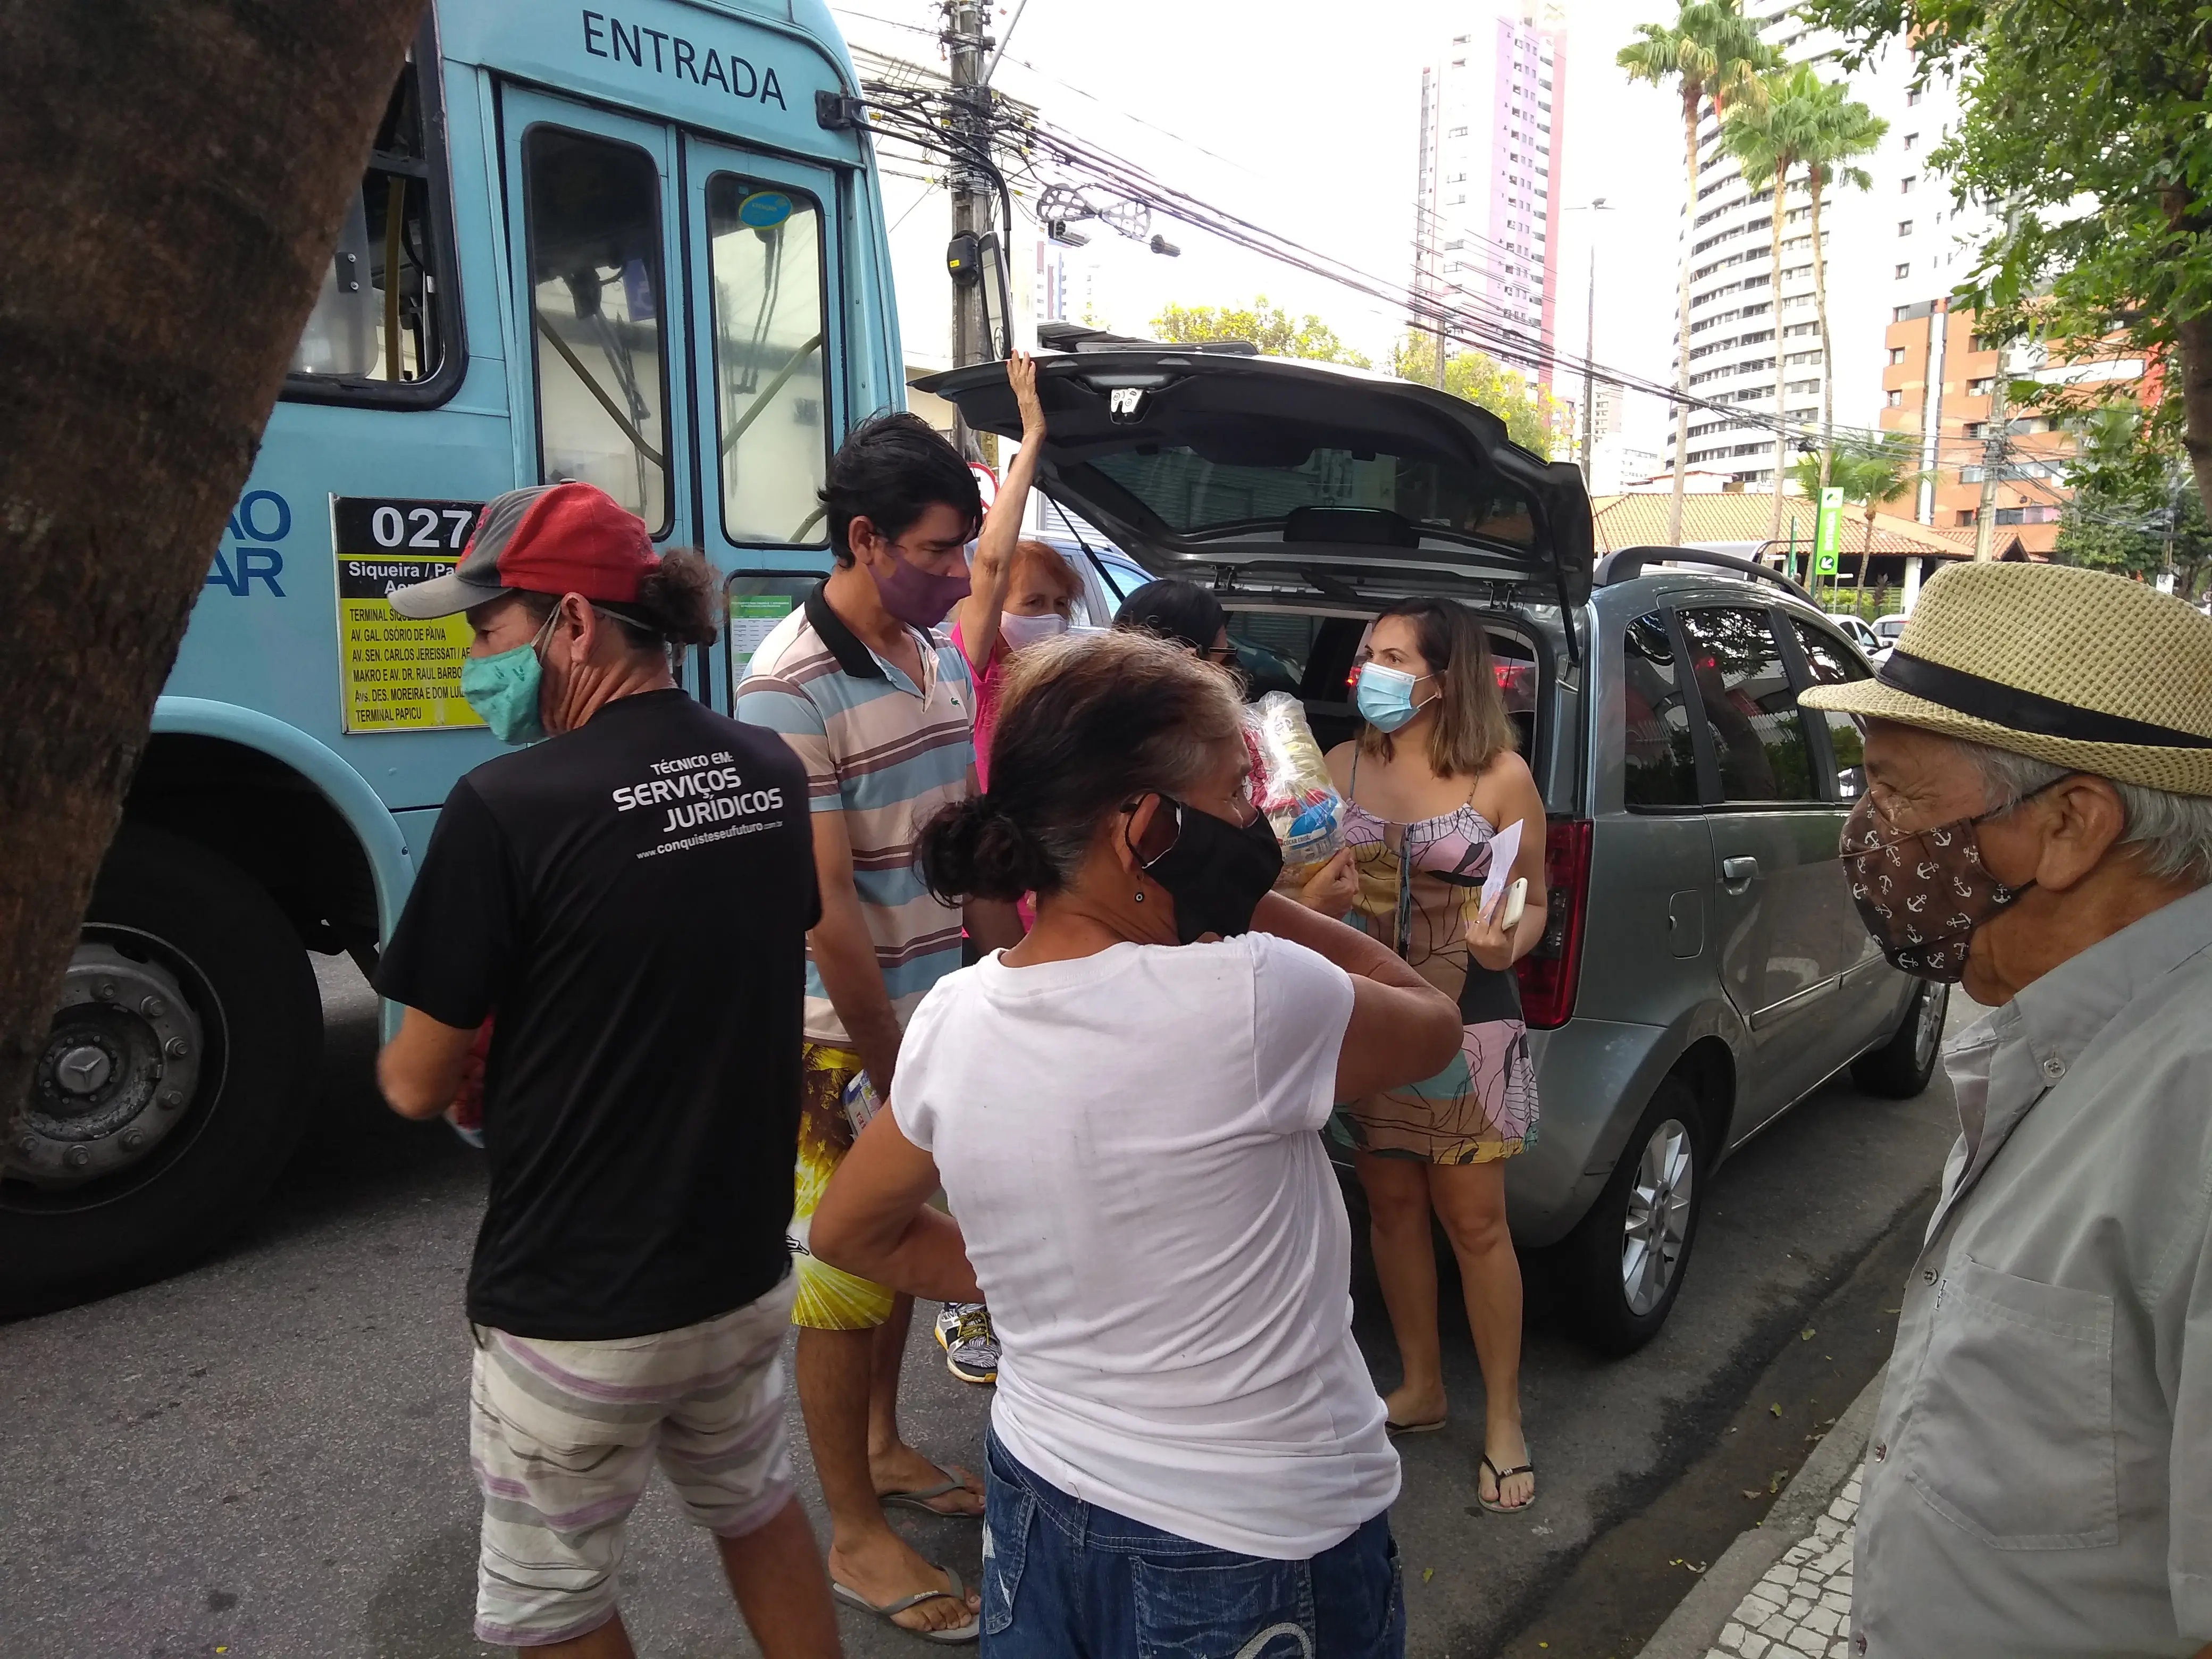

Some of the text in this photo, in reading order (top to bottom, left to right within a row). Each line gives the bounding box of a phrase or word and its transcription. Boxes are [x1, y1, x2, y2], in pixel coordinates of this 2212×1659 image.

[582, 9, 787, 111] ENTRADA
[372, 506, 472, 548] 027
[349, 562, 456, 580] Siqueira / Pa
[349, 608, 388, 622] TERMINAL
[351, 629, 362, 642] AV.
[364, 629, 382, 641] GAL.
[383, 626, 413, 641] OSÓRIO
[414, 629, 424, 641] DE
[352, 649, 364, 662] AV.
[365, 649, 382, 661] SEN.
[384, 648, 415, 661] CARLOS
[416, 648, 456, 661] JEREISSATI
[353, 667, 463, 682] MAKRO E AV. DR. RAUL BARBO
[372, 689, 389, 702] DES.
[391, 688, 424, 701] MOREIRA
[426, 688, 430, 700] E
[433, 686, 448, 699] DOM
[356, 707, 422, 723] TERMINAL PAPICU
[650, 750, 735, 775] TÉCNICO EM:
[612, 767, 742, 812] SERVIÇOS
[663, 787, 784, 833] JURÍDICOS
[636, 820, 783, 859] www.conquisteseufuturo.com.br
